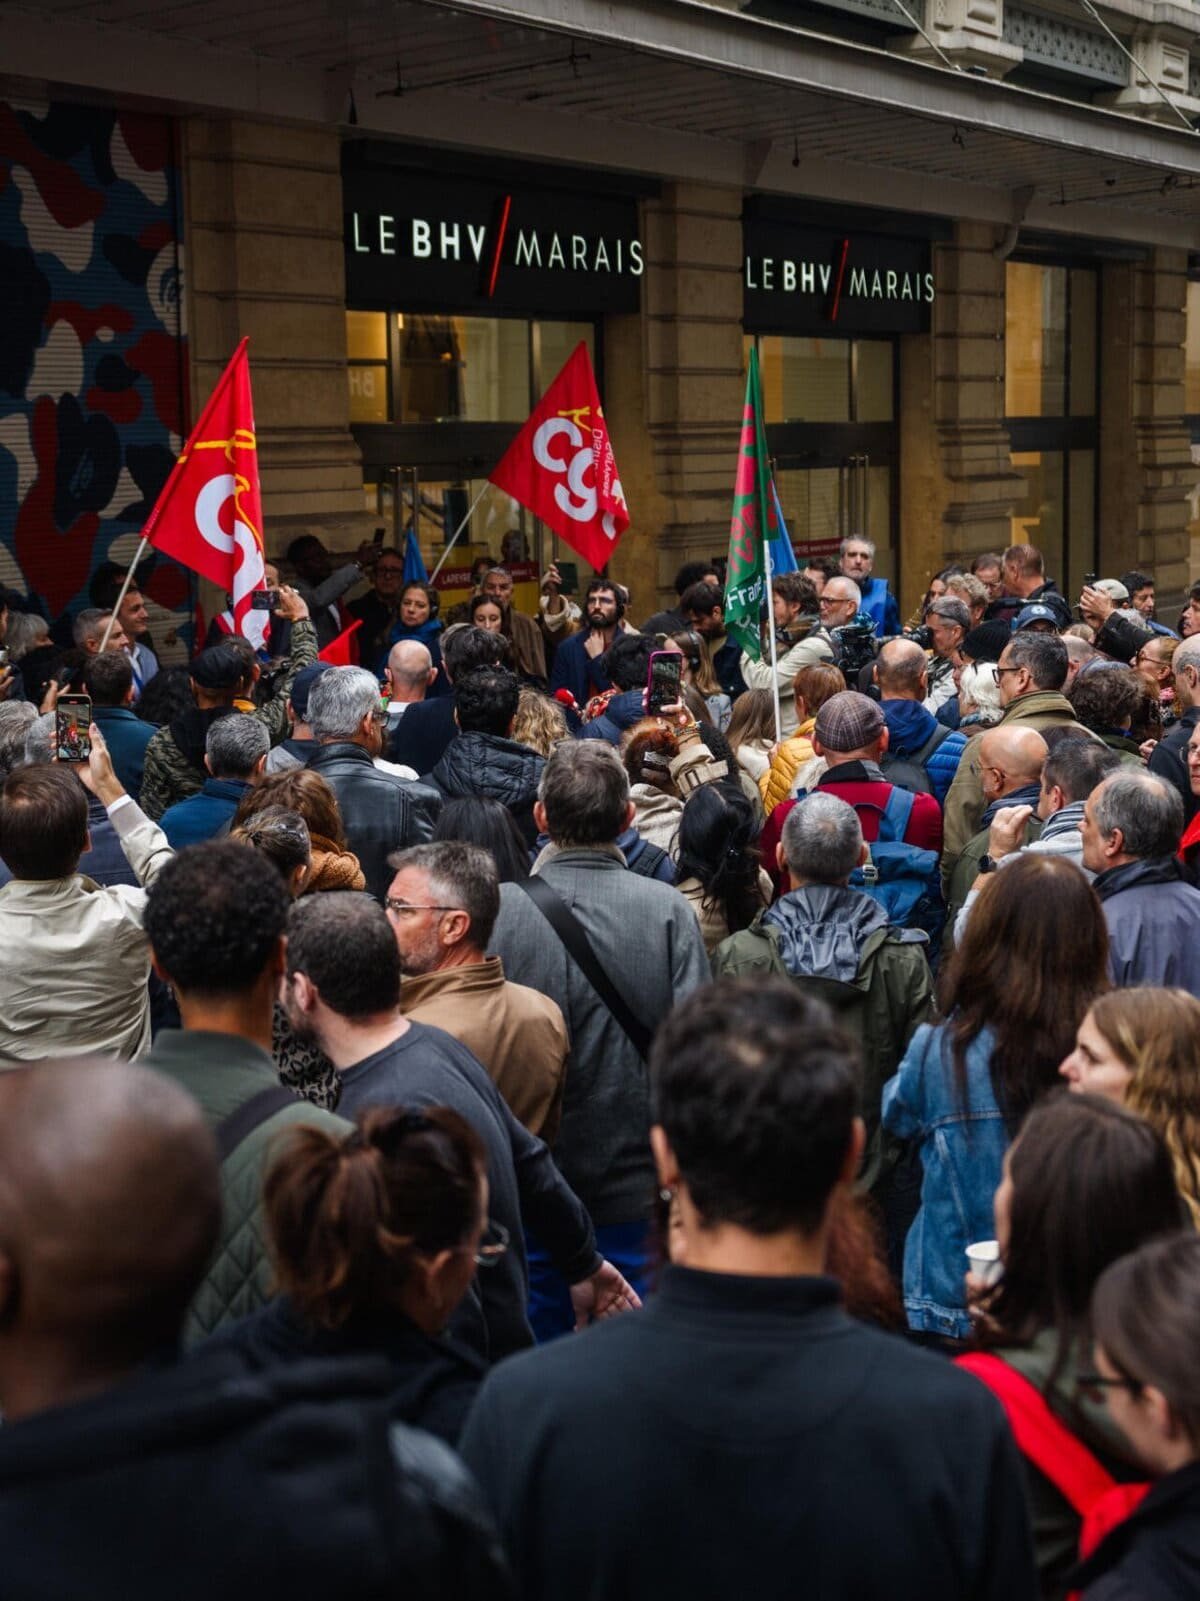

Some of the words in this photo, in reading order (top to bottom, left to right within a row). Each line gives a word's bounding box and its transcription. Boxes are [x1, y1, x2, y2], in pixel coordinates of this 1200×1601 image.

[353, 212, 396, 255] LE
[412, 218, 486, 262] BHV
[515, 230, 644, 275] MARAIS
[747, 256, 773, 290] LE
[783, 260, 831, 293] BHV
[849, 268, 935, 304] MARAIS
